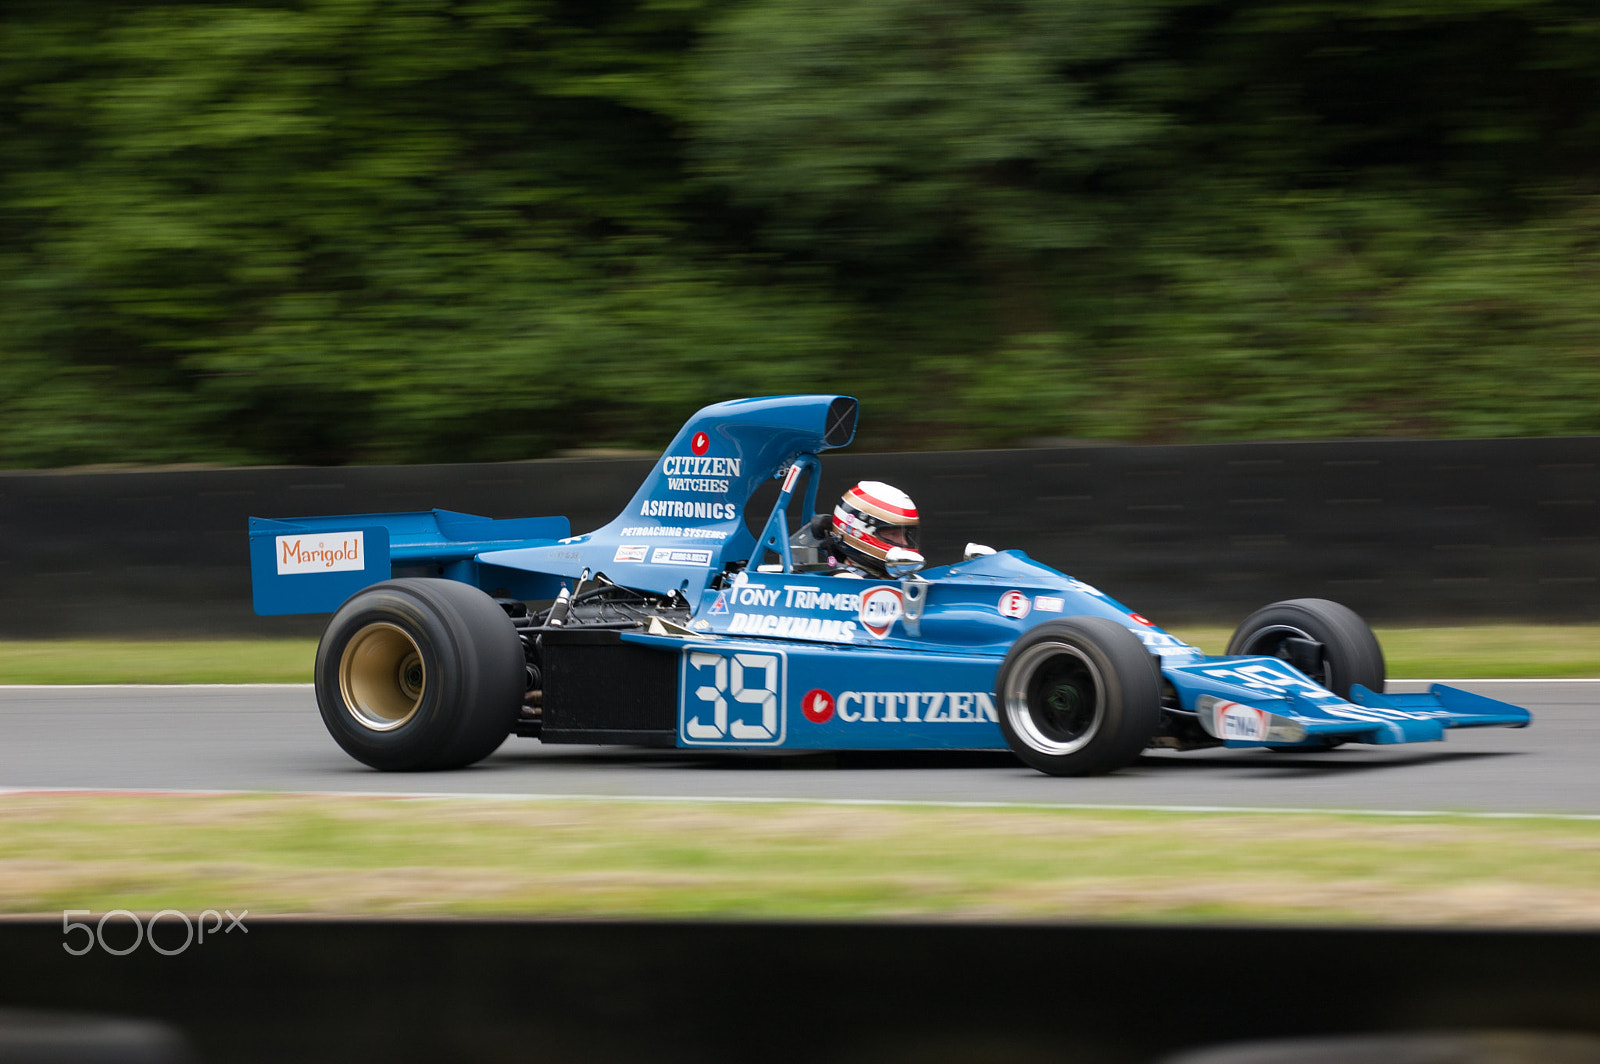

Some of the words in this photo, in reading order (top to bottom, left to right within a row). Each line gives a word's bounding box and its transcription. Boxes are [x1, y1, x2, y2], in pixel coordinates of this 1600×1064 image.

[663, 456, 741, 477] CITIZEN
[668, 478, 729, 493] WATCHES
[640, 500, 736, 519] ASHTRONICS
[682, 527, 728, 540] SYSTEMS
[282, 538, 358, 567] Marigold
[867, 600, 898, 617] FINA
[727, 612, 857, 641] DUCKHAMS
[686, 651, 778, 739] 39
[836, 691, 1000, 723] CITIZEN
